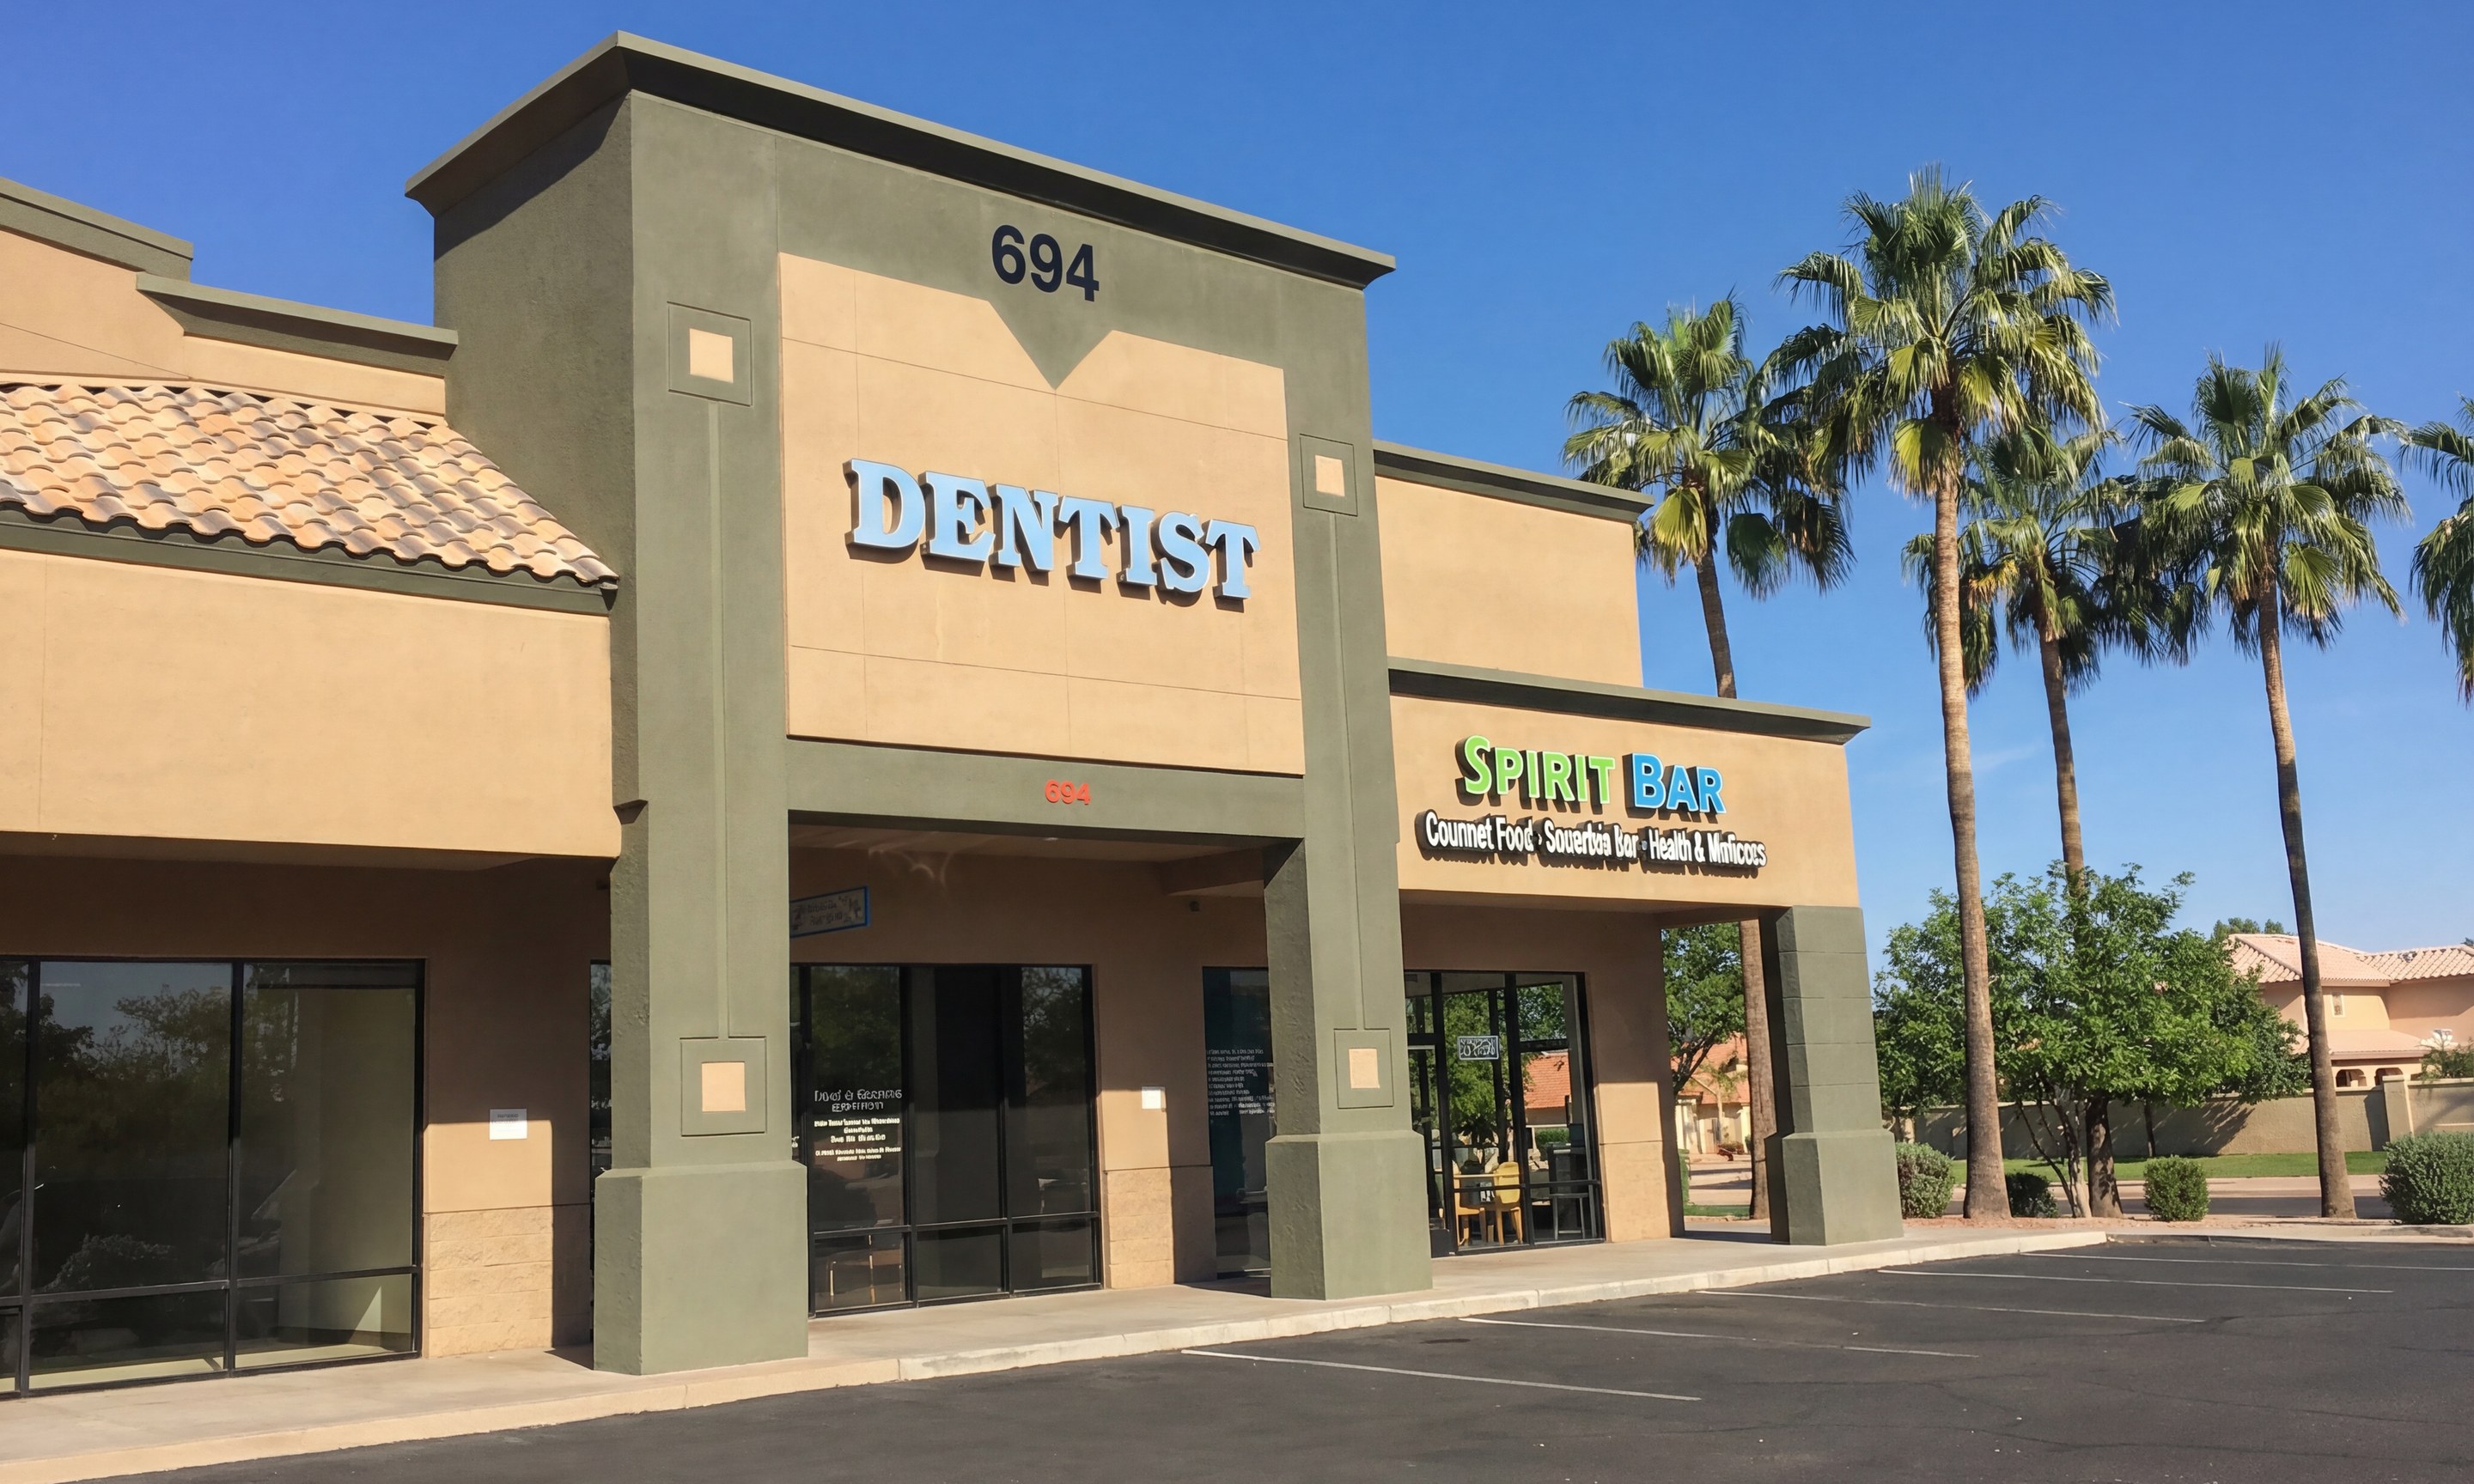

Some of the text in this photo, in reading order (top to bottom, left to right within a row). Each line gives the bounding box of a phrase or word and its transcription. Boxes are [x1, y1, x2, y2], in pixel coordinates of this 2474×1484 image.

[992, 224, 1100, 302] 694
[847, 458, 1261, 600] DENTIST
[1044, 779, 1091, 806] 694
[1648, 828, 1693, 862] Health
[1693, 830, 1706, 863] &
